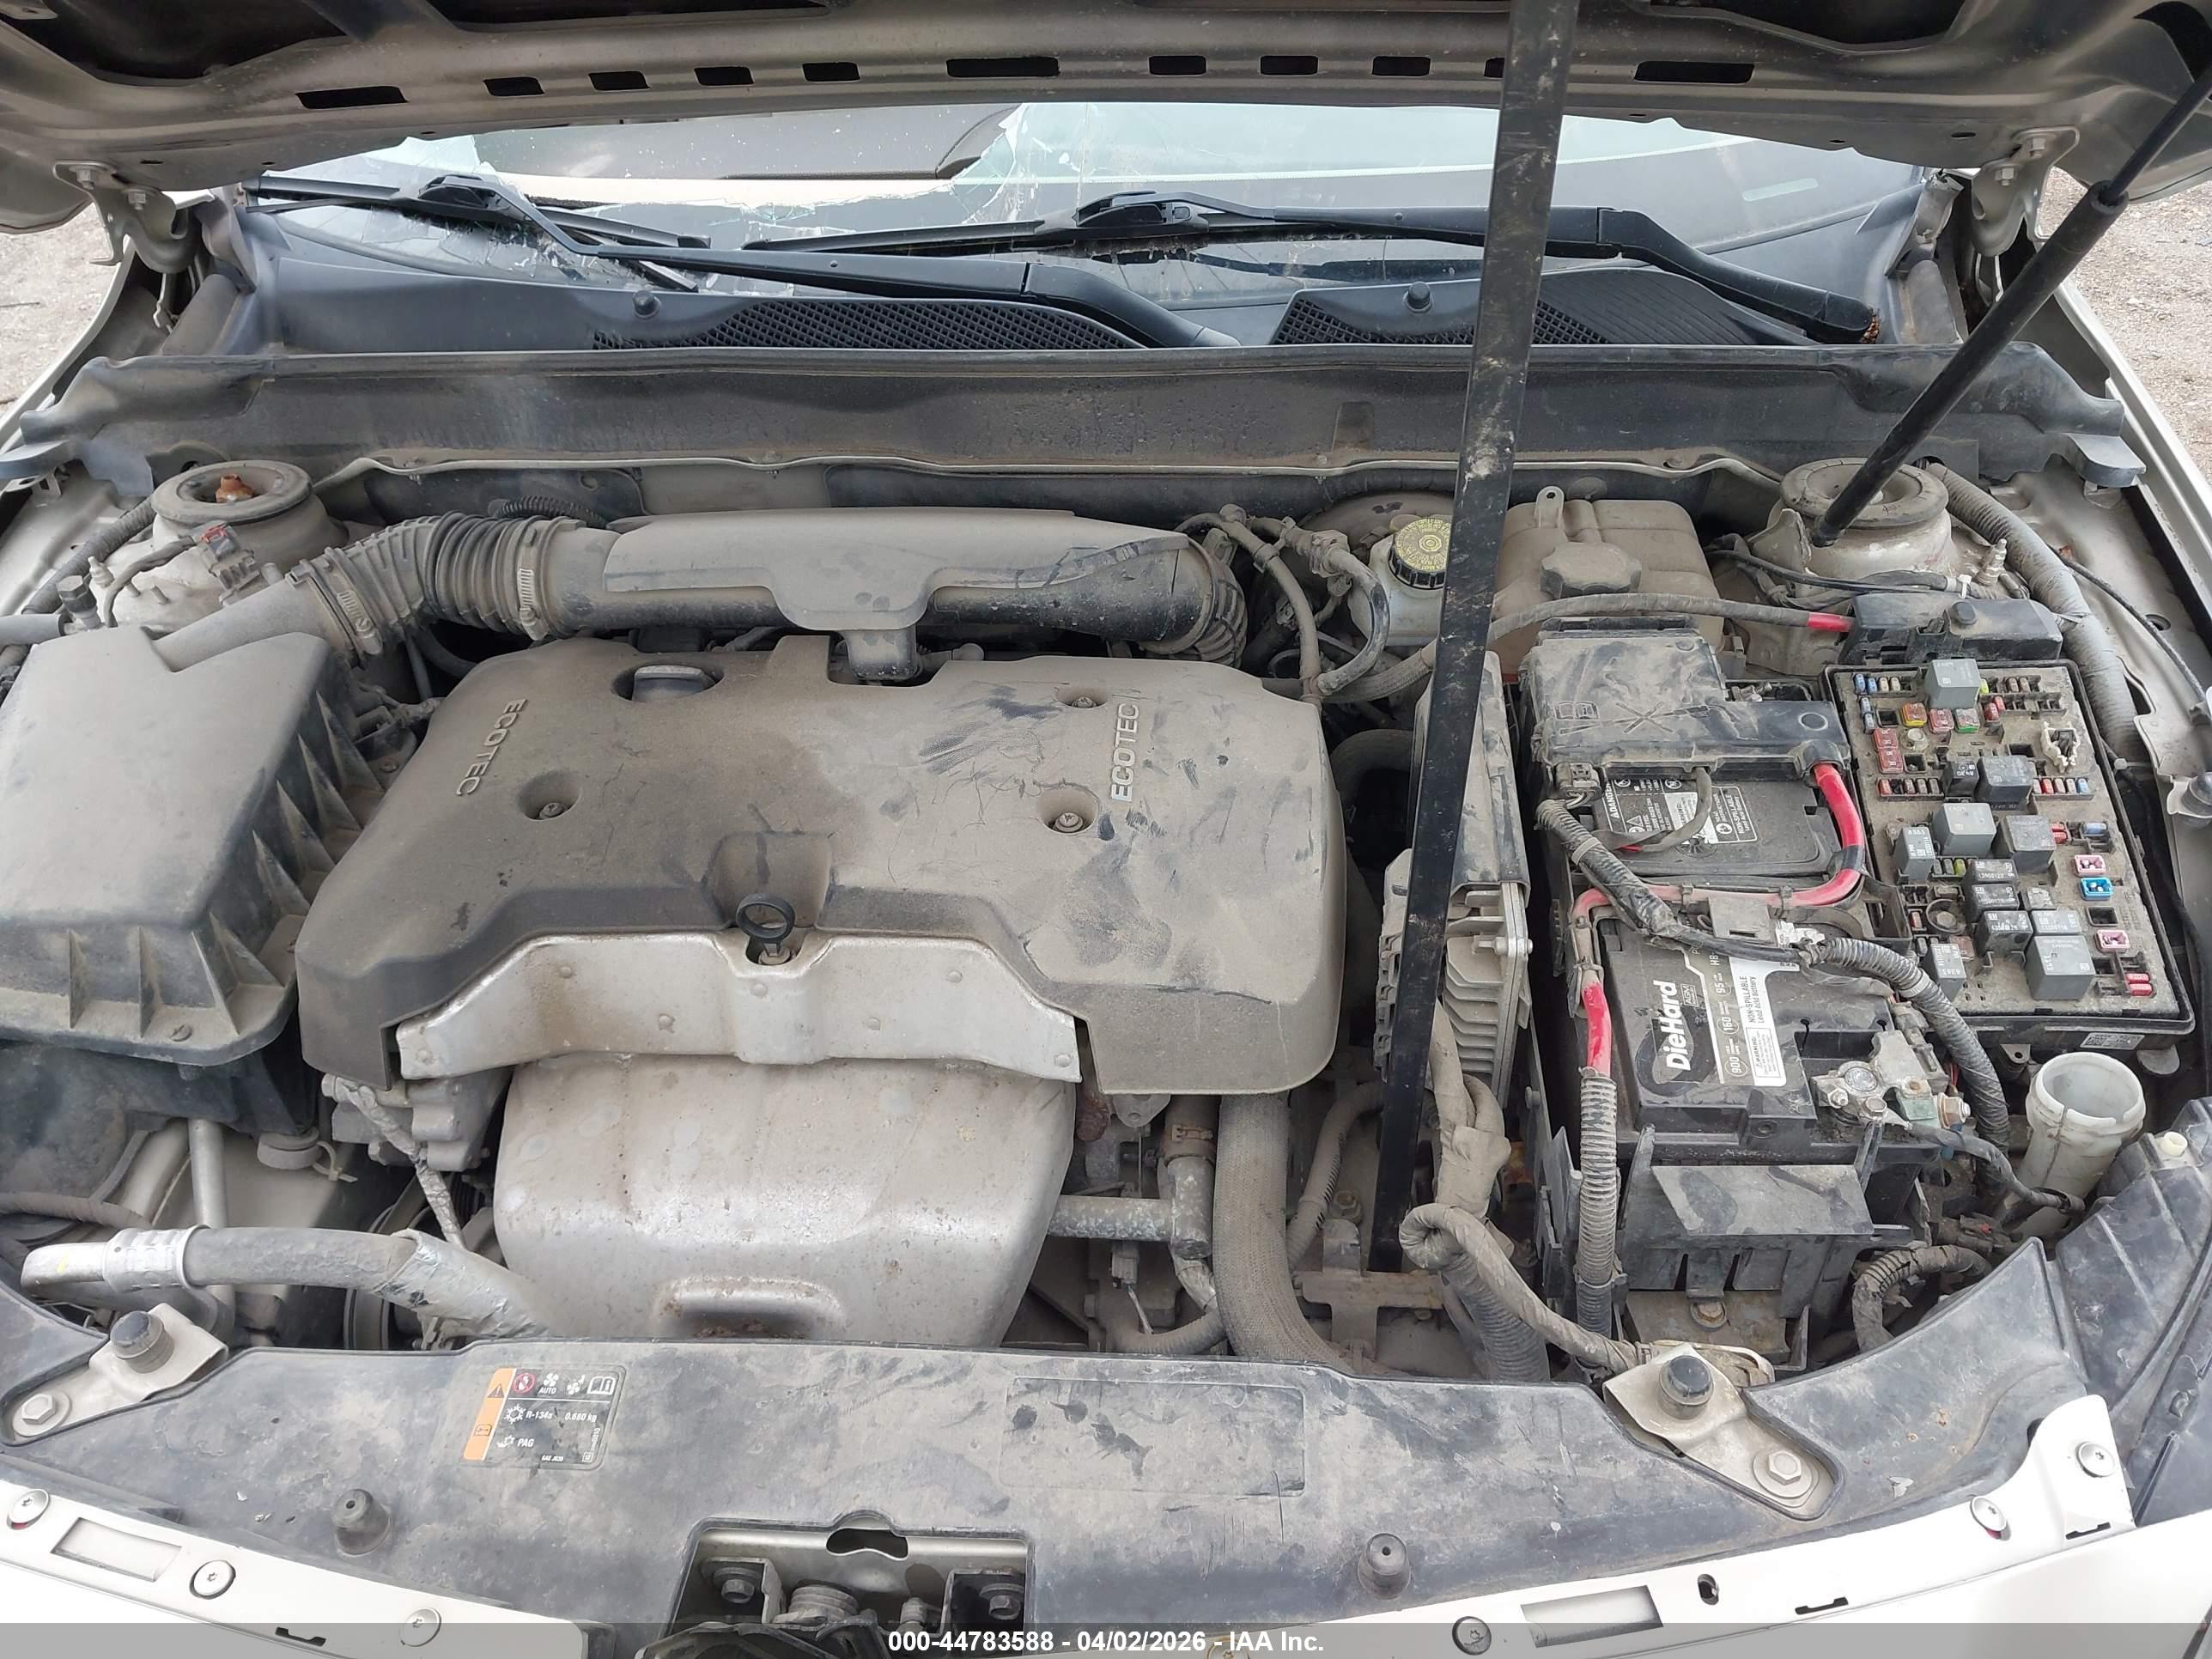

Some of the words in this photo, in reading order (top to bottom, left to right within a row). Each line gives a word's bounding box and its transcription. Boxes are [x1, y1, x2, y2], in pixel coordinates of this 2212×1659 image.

[457, 698, 527, 795] ECOTEC
[1111, 703, 1139, 802] ECOTEC
[1726, 794, 1746, 834] NON-SPILLABLE
[1683, 985, 1692, 1005] AGM
[1714, 982, 1726, 994] 95
[1750, 976, 1759, 996] Battery
[1739, 975, 1756, 1024] NON-SPILLABLE
[1752, 997, 1761, 1009] Acid
[1721, 1016, 1735, 1031] 160
[1755, 1008, 1765, 1024] Lead
[1653, 980, 1691, 1072] DieHard
[1729, 1056, 1742, 1073] 900
[526, 1411, 553, 1419] R-134a
[586, 1413, 598, 1423] kg
[517, 1437, 534, 1448] PAG
